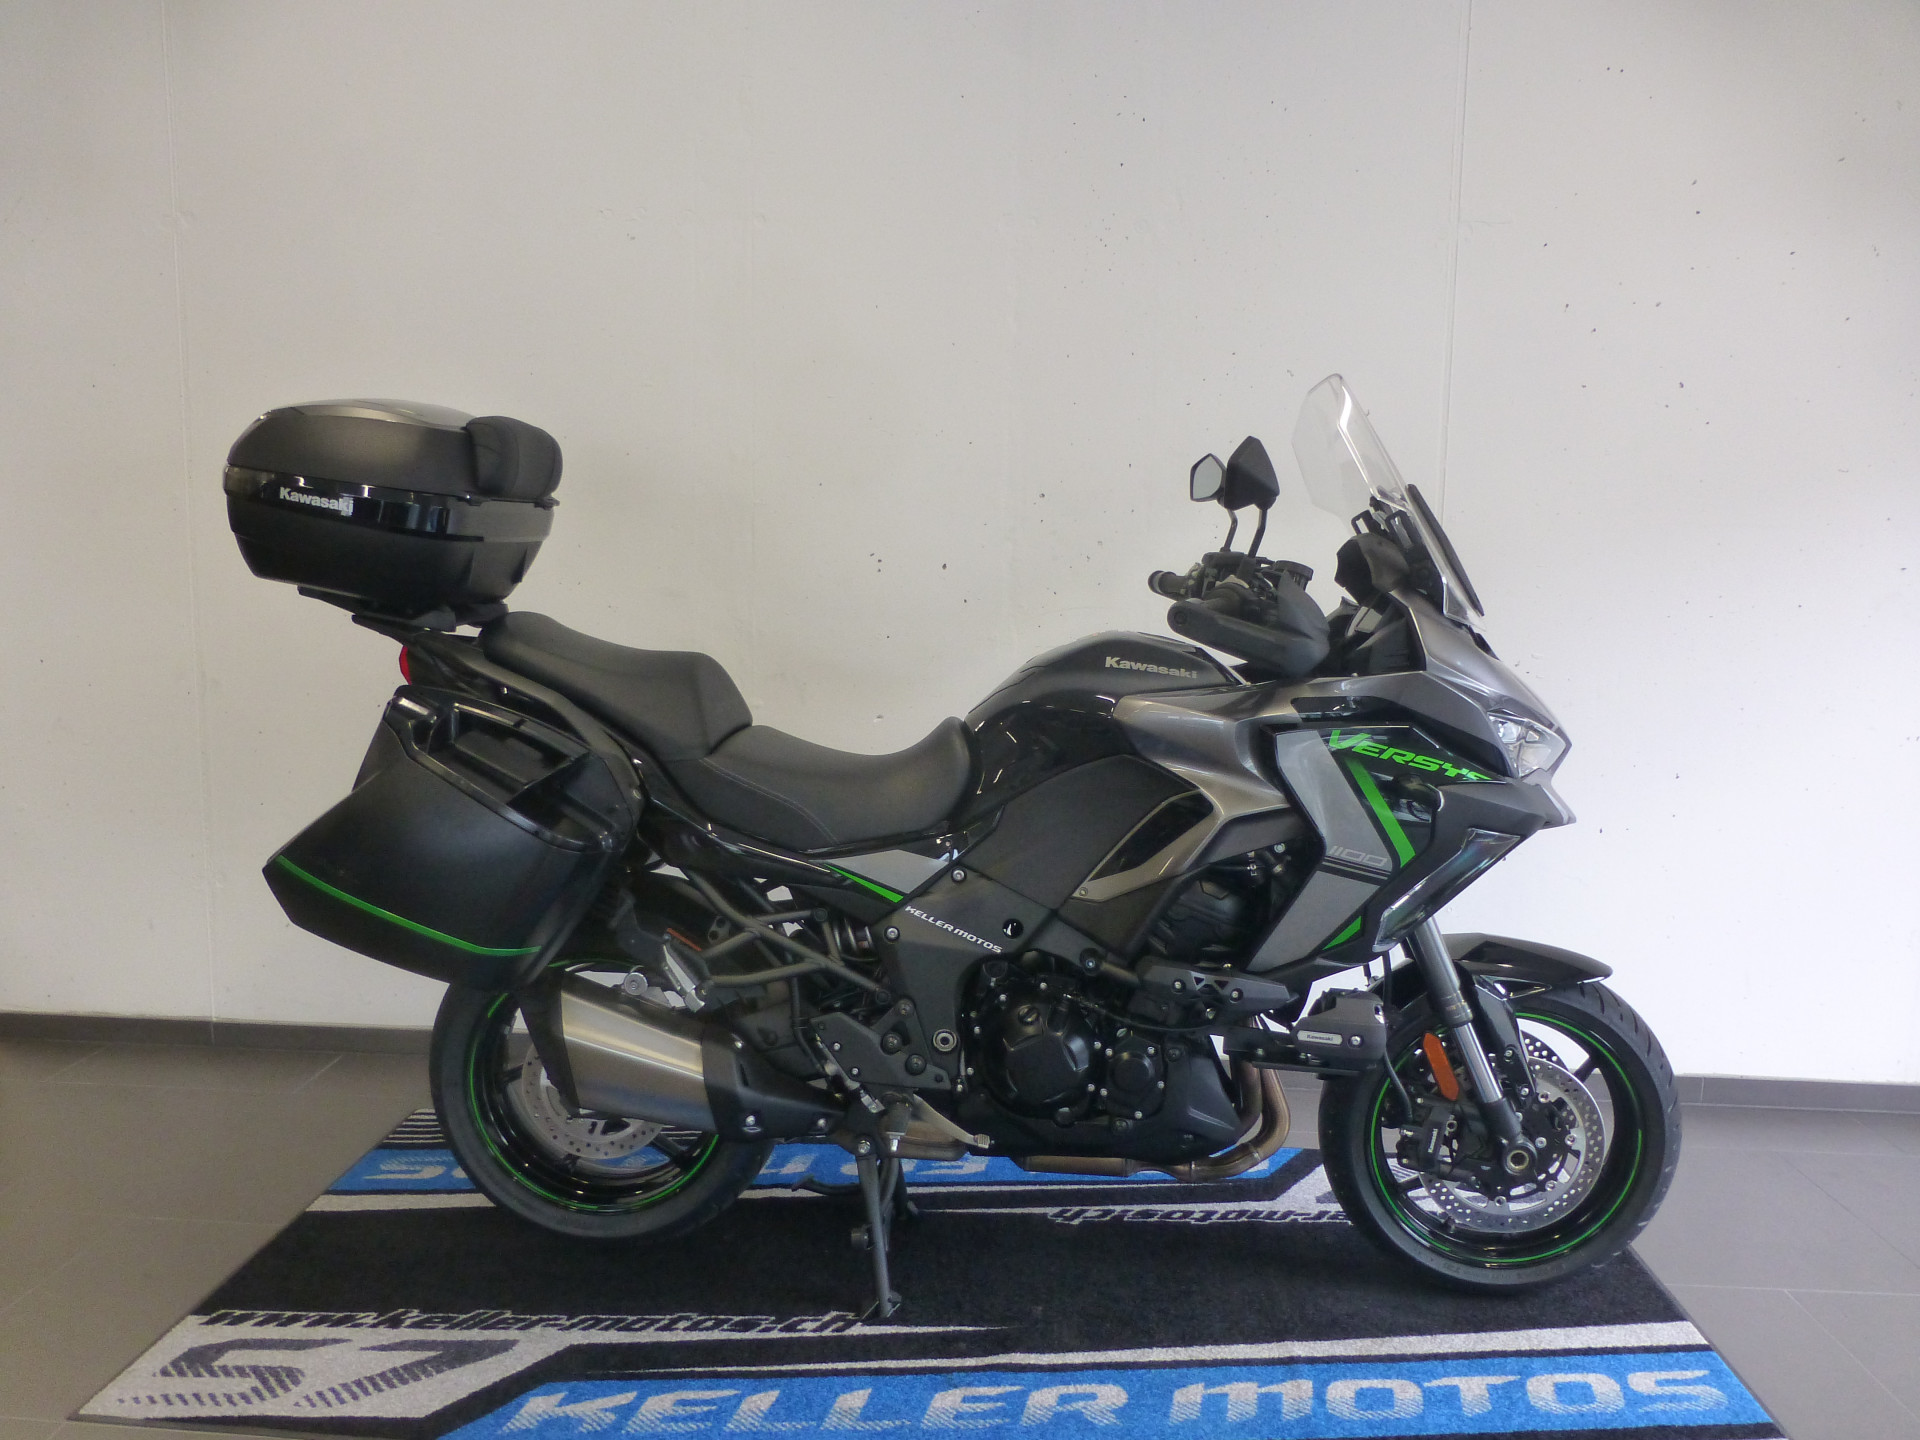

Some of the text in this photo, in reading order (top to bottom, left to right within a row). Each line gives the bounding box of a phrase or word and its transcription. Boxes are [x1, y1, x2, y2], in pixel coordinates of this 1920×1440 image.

[279, 486, 354, 515] Kawasaki
[1104, 656, 1198, 679] Kawasaki
[904, 905, 1003, 953] KELLER MOTOS
[1306, 1034, 1334, 1042] Kawasaki
[198, 1309, 861, 1332] www.keller-motos.ch
[501, 1368, 1729, 1434] KELLER MOTOS
